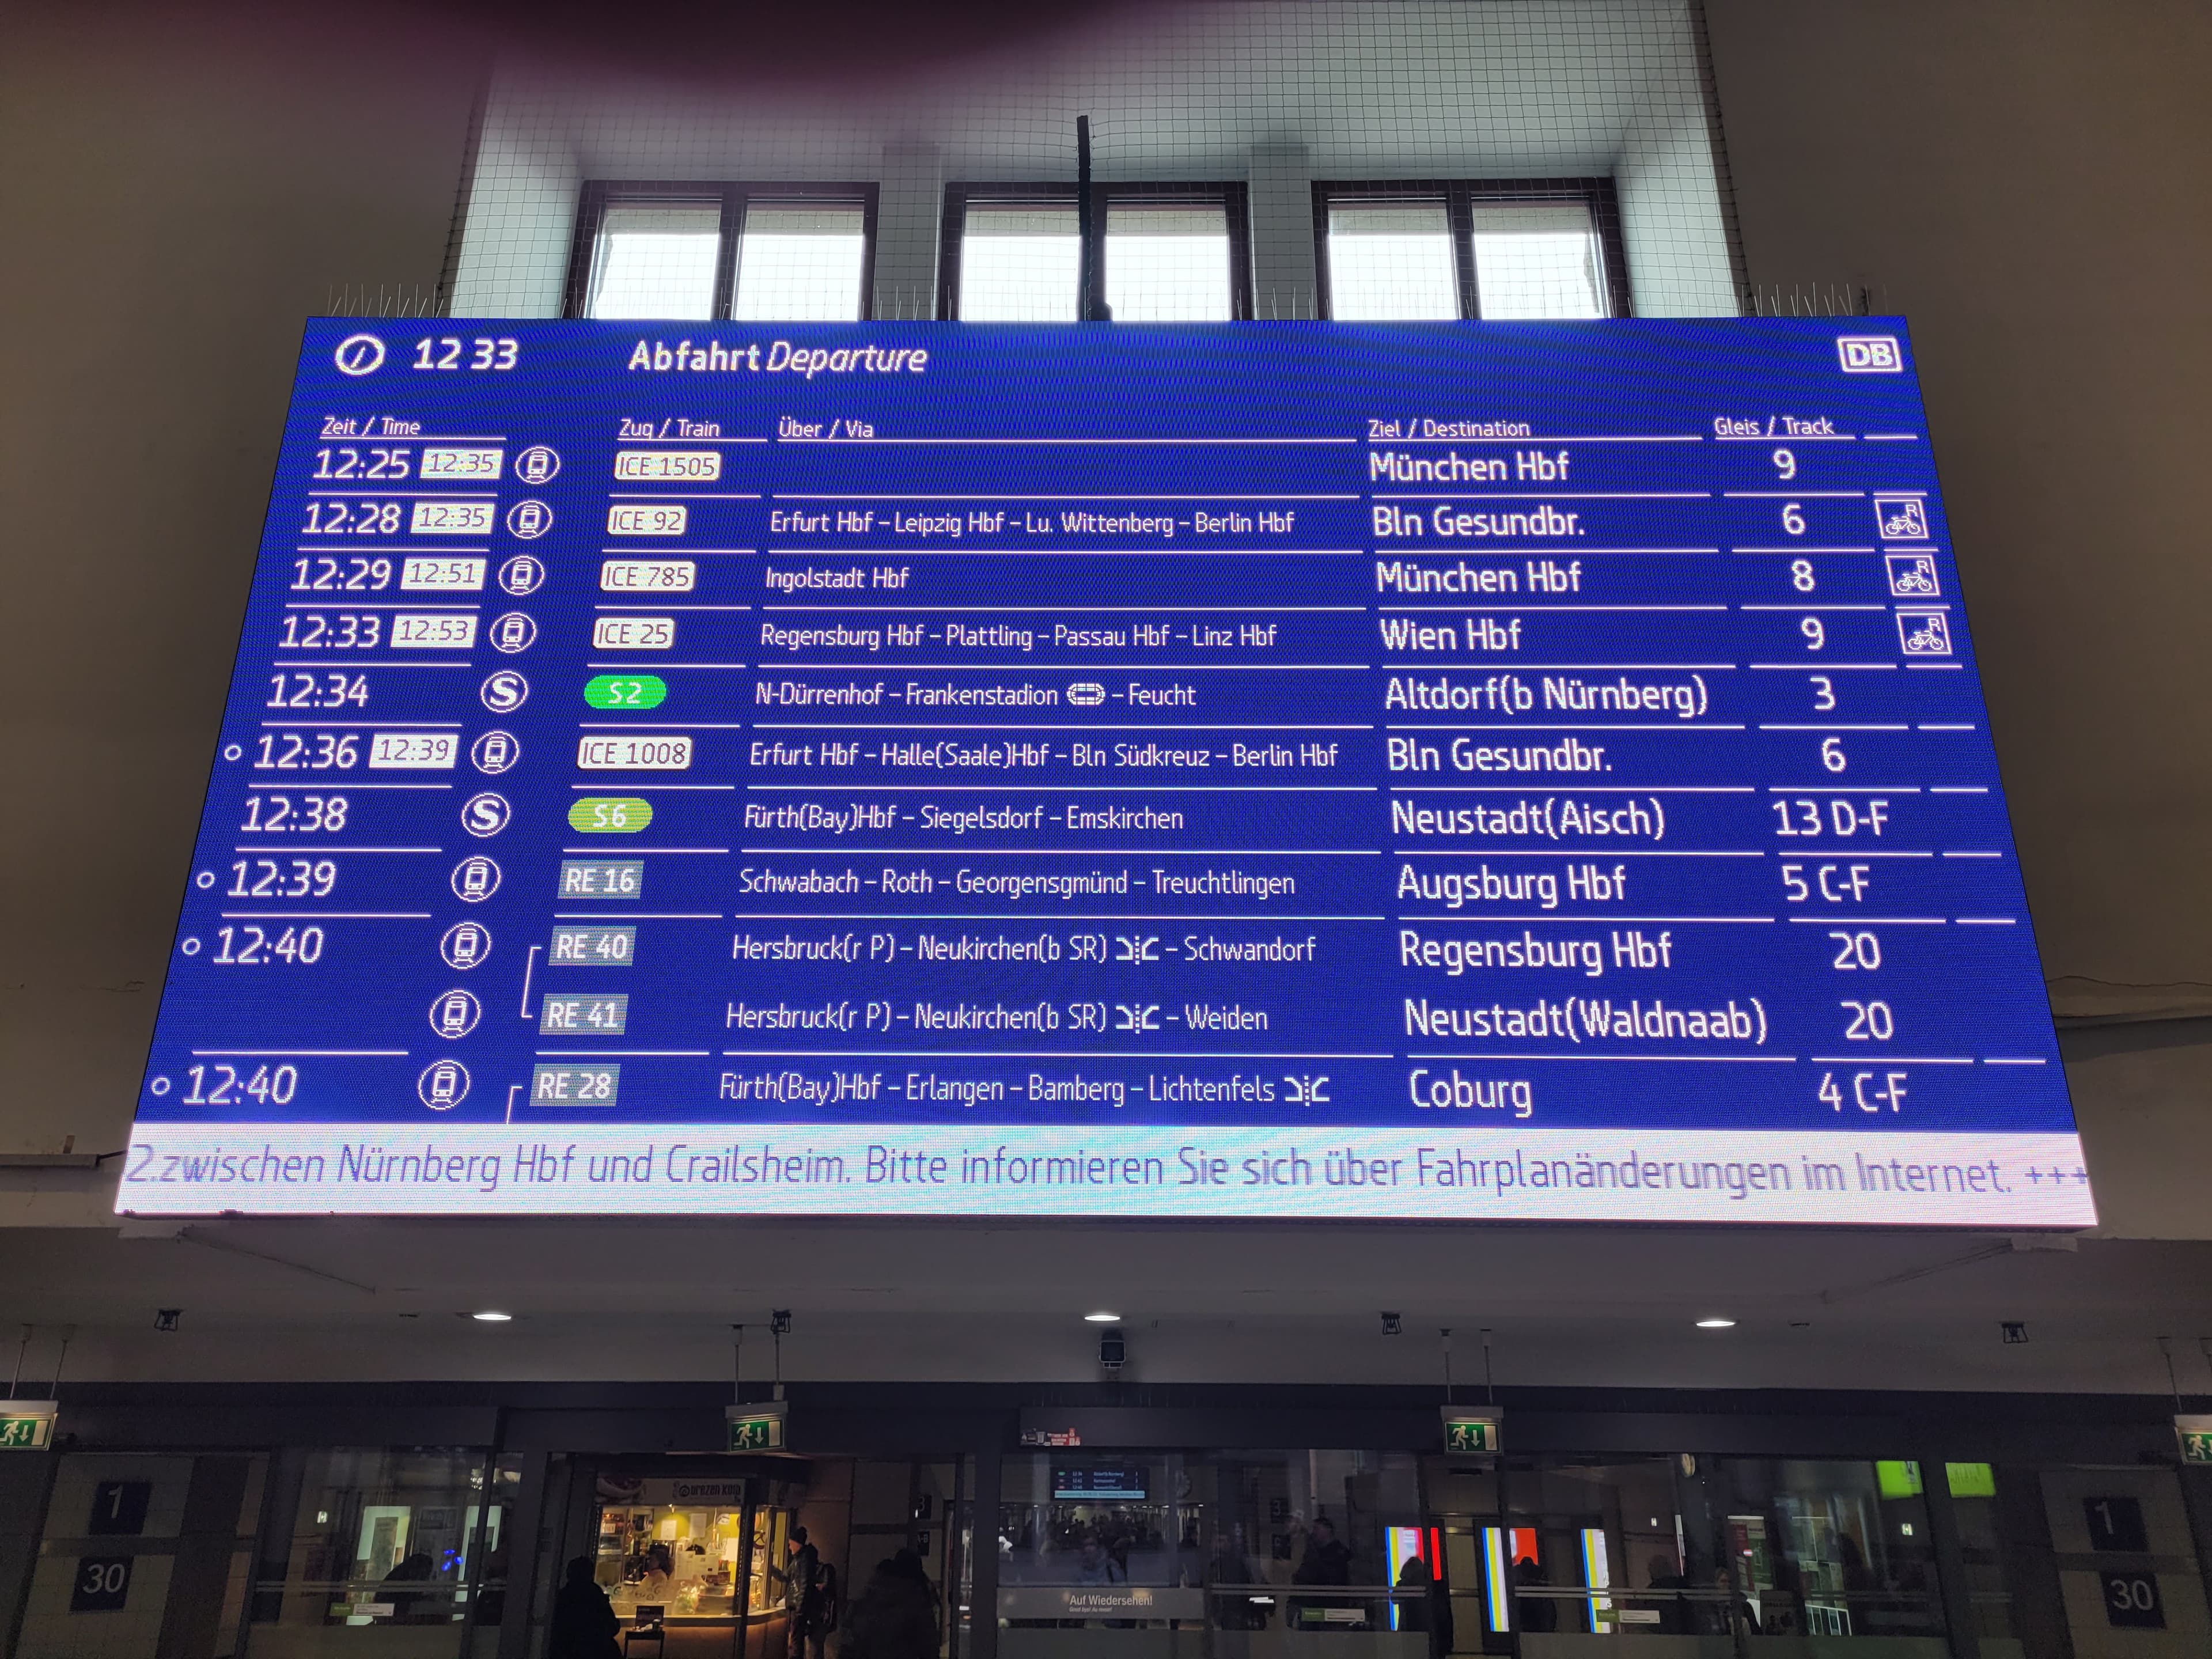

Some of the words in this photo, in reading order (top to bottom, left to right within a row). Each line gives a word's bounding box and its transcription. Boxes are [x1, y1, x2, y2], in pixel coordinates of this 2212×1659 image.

[628, 340, 760, 371] Abfahrt
[766, 341, 927, 379] Departure
[1847, 342, 1894, 368] DB
[322, 416, 356, 434] Zeit
[382, 417, 421, 435] Time
[620, 419, 653, 438] Zug
[678, 419, 719, 437] Train
[779, 416, 822, 437] Über
[846, 421, 873, 438] Via
[1369, 419, 1400, 437] Ziel
[1424, 419, 1530, 437] Destination
[1714, 418, 1760, 435] Gleis
[1782, 416, 1834, 435] Track
[313, 449, 410, 479] 12:25
[429, 453, 494, 473] 12:35
[617, 456, 652, 476] ICE
[660, 457, 715, 476] 1505
[1370, 452, 1506, 481] München
[1517, 451, 1569, 480] Hbf
[1774, 449, 1795, 479] 9
[302, 503, 402, 533] 12:28
[419, 506, 485, 528] 12:35
[609, 510, 645, 531] ICE
[654, 511, 681, 531] 92
[771, 511, 829, 532] Erfurt
[838, 512, 873, 532] Hbf
[896, 512, 961, 537] Leipzig
[969, 512, 1003, 532] Hbf
[1027, 513, 1054, 532] Lu.
[1062, 512, 1173, 537] Wittenberg
[1196, 512, 1251, 532] Berlin
[1259, 512, 1294, 532] Hbf
[1373, 506, 1422, 536] Bln
[1434, 505, 1584, 536] Gesundbr.
[1783, 504, 1805, 535] 6
[291, 559, 391, 590] 12:29
[410, 562, 478, 584] 12:51
[603, 566, 639, 587] ICE
[648, 566, 689, 587] 785
[767, 567, 865, 593] Ingolstadt
[873, 567, 908, 588] Hbf
[1377, 562, 1517, 592] München
[1528, 561, 1581, 592] Hbf
[1791, 560, 1815, 591] 8
[279, 616, 380, 647] 12:33
[400, 619, 469, 641] 12:53
[596, 623, 632, 645] ICE
[639, 623, 668, 645] 25
[762, 623, 880, 651] Regensburg
[888, 624, 923, 646] Hbf
[947, 624, 1032, 651] Plattling
[1055, 624, 1125, 646] Passau
[1134, 624, 1169, 646] Hbf
[1194, 626, 1232, 646] Linz
[1241, 624, 1277, 646] Hbf
[1380, 619, 1456, 650] Wien
[1467, 619, 1521, 650] Hbf
[1801, 618, 1824, 649] 9
[267, 675, 368, 707] 12:34
[608, 681, 642, 704] S2
[756, 682, 883, 704] N-Dürrenhof
[907, 683, 1058, 705] Frankenstadion
[1130, 683, 1195, 705] Feucht
[1385, 675, 1533, 715] Altdorf(b
[1544, 675, 1707, 718] Nürnberg)
[1810, 677, 1835, 710] 3
[255, 735, 359, 768] 12:36
[379, 738, 449, 761] 12:39
[580, 742, 618, 764] ICE
[626, 742, 687, 765] 1008
[751, 743, 812, 766] Erfurt
[821, 743, 858, 765] Hbf
[882, 742, 1049, 768] Halle(Saale)Hbf
[1073, 744, 1105, 766] Bln
[1115, 744, 1209, 766] Südkreuz
[1233, 744, 1293, 766] Berlin
[1301, 744, 1338, 766] Hbf
[1388, 738, 1440, 771] Bln
[1452, 738, 1611, 771] Gesundbr.
[1822, 738, 1846, 771] 6
[241, 797, 348, 831] 12:38
[593, 804, 627, 828] S6
[745, 804, 896, 834] Fürth(Bay)Hbf
[921, 805, 1043, 834] Siegelsdorf
[1068, 805, 1183, 829] Emskirchen
[1392, 798, 1664, 840] Neustadt(Aisch)
[1773, 801, 1821, 835] 13
[1831, 801, 1888, 835] D-F
[228, 861, 336, 896] 12:39
[566, 868, 596, 892] RE
[604, 868, 635, 892] 16
[740, 869, 858, 893] Schwabach
[882, 869, 932, 893] Roth
[957, 869, 1127, 899] Georgensgmünd
[1153, 870, 1294, 900] Treuchtlingen
[1398, 864, 1558, 908] Augsburg
[1568, 865, 1626, 900] Hbf
[1782, 865, 1808, 900] 5
[1819, 866, 1869, 901] C-F
[214, 927, 324, 963] 12:40
[556, 934, 588, 959] RE
[596, 934, 628, 959] 40
[733, 933, 861, 963] Hersbruck(r
[871, 934, 894, 963] P)
[919, 934, 1060, 963] Neukirchen(b
[1070, 934, 1106, 963] SR)
[1185, 935, 1315, 961] Schwandorf
[1401, 930, 1603, 976] Regensburg
[1612, 931, 1672, 967] Hbf
[1830, 933, 1880, 969] 20
[548, 1002, 579, 1028] RE
[588, 1002, 618, 1028] 41
[727, 1002, 857, 1031] Hersbruck(r
[866, 1002, 890, 1032] P)
[915, 1002, 1058, 1032] Neukirchen(b
[1069, 1003, 1105, 1032] SR)
[1185, 1005, 1267, 1029] Weiden
[1405, 997, 1766, 1044] Neustadt(Waldnaab)
[1841, 1002, 1893, 1039] 20
[184, 1066, 297, 1104] 12:40
[538, 1073, 570, 1099] RE
[578, 1073, 611, 1099] 28
[721, 1072, 881, 1106] Fürth(Bay)Hbf
[907, 1074, 1003, 1107] Erlangen
[1029, 1074, 1124, 1107] Bamberg
[1150, 1075, 1274, 1101] Lichtenfels
[1410, 1069, 1532, 1118] Coburg
[1819, 1073, 1842, 1111] 4
[1854, 1073, 1906, 1112] C-F
[338, 1144, 501, 1193] Nürnberg
[513, 1144, 577, 1183] Hbf
[589, 1145, 654, 1183] und
[665, 1145, 852, 1184] Crailsheim.
[866, 1145, 948, 1184] Bitte
[962, 1146, 1163, 1185] informieren
[1178, 1147, 1228, 1185] Sie
[1242, 1147, 1312, 1185] sich
[1324, 1148, 1400, 1187] über
[1417, 1148, 1791, 1200] Fahrplanänderungen
[1800, 1154, 1845, 1191] im
[1855, 1152, 2013, 1194] Internet.
[108, 1484, 124, 1519] 1
[2094, 1501, 2115, 1536] 1
[82, 1563, 126, 1594] 30
[1069, 1594, 1086, 1606] Auf
[1088, 1594, 1153, 1606] Wiedersehen!
[2109, 1578, 2154, 1612] 30
